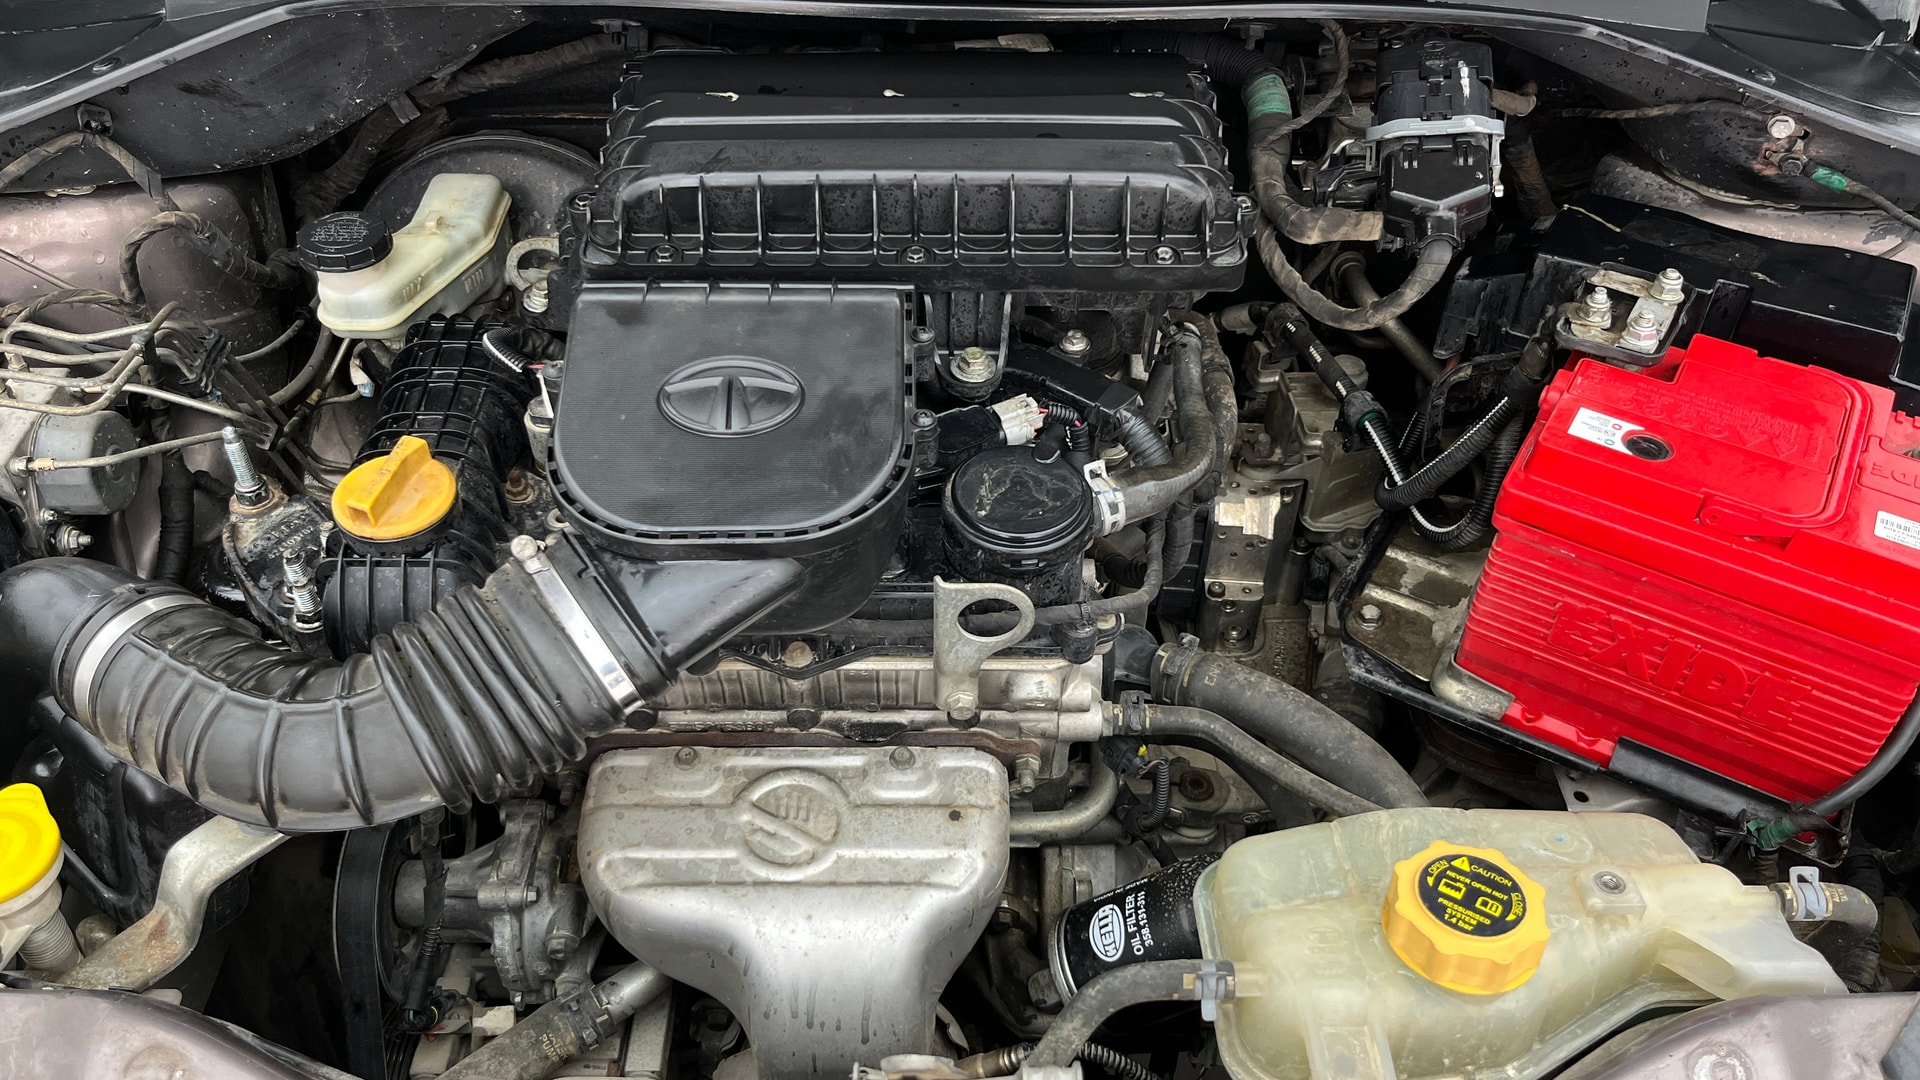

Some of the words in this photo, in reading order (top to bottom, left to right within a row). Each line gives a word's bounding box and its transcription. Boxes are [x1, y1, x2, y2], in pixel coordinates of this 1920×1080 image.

[1203, 661, 1224, 687] END
[1547, 602, 1812, 732] EXIDE
[1428, 859, 1449, 874] OPEN
[1471, 864, 1513, 888] CAUTION
[1446, 870, 1471, 885] NEVER
[1471, 881, 1493, 894] OPEN
[1492, 890, 1509, 901] HOT
[1125, 893, 1138, 933] FILTER
[1438, 897, 1492, 926] PRESSURISED
[1445, 907, 1478, 926] SYSTEM
[1511, 892, 1524, 917] CLOSE
[1098, 904, 1118, 957] HELLA
[1136, 891, 1154, 948] 358.131-311
[1444, 913, 1457, 924] 1.4
[1457, 919, 1474, 931] bar
[1131, 932, 1145, 956] OIL
